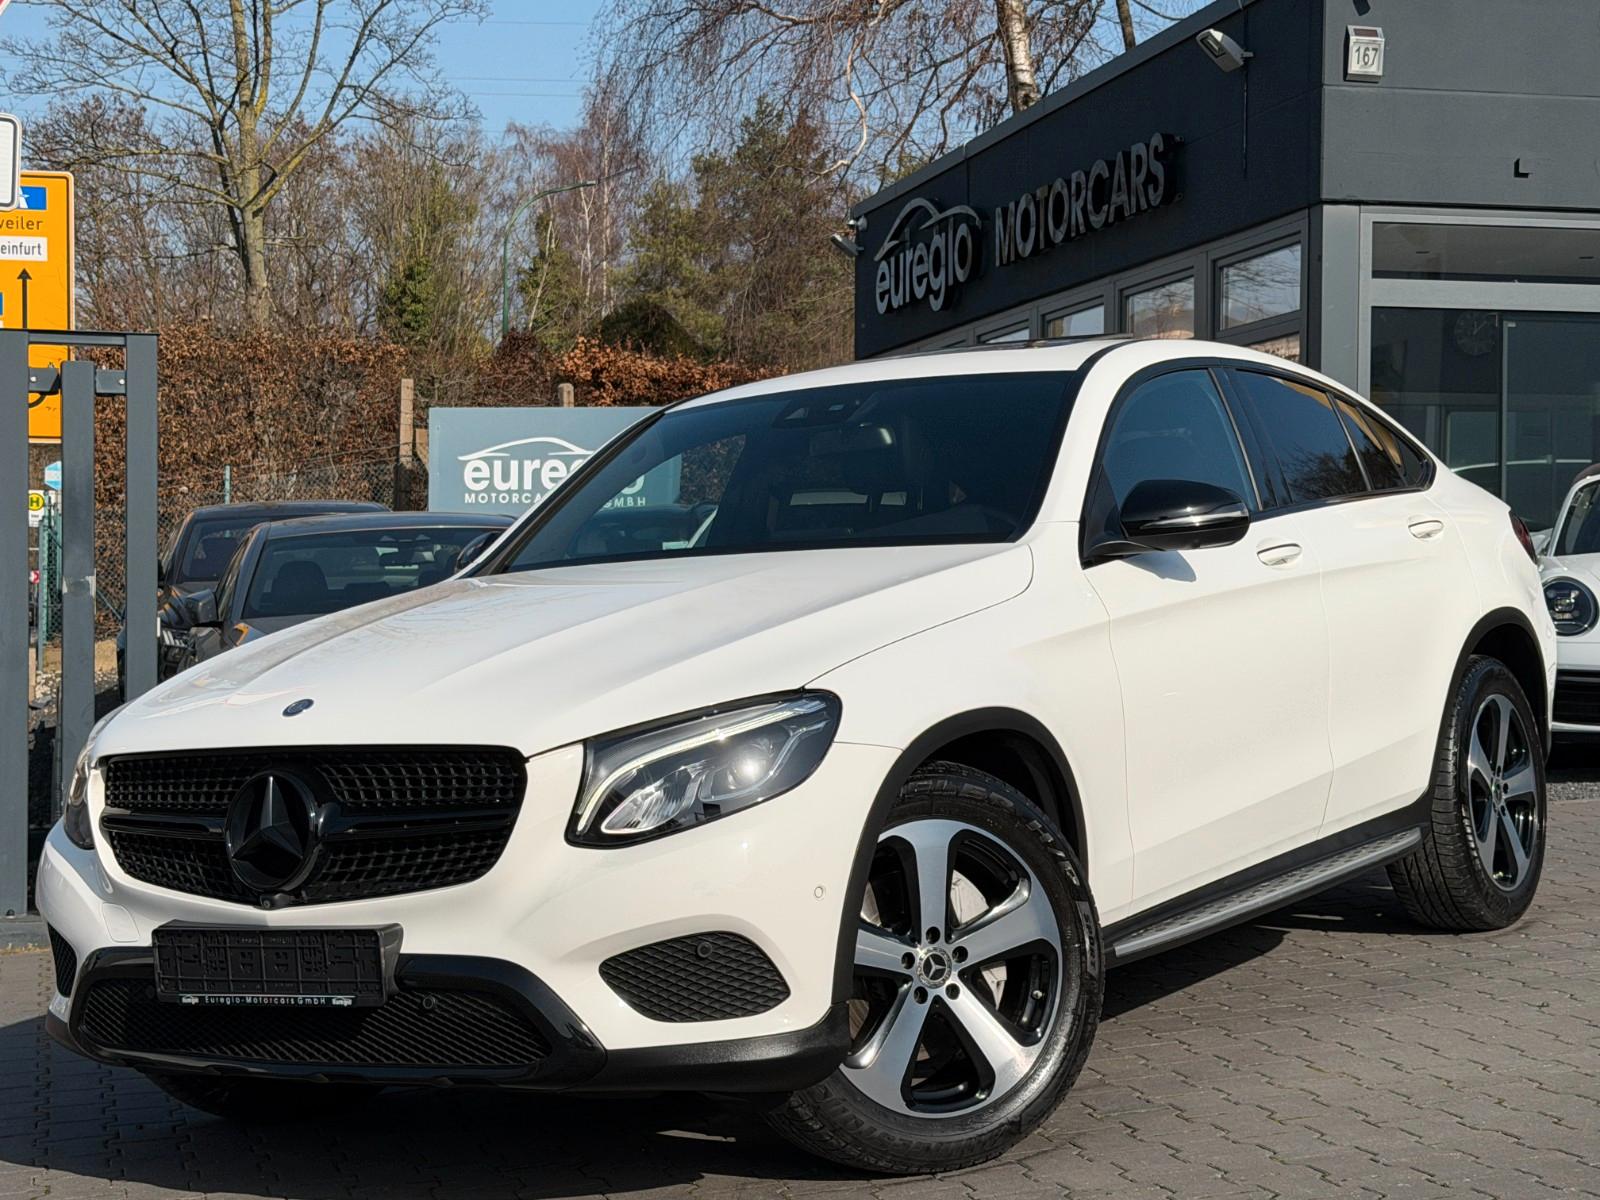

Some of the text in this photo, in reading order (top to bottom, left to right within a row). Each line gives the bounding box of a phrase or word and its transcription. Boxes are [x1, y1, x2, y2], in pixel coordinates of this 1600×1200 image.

[1355, 46, 1379, 66] 167
[995, 132, 1165, 267] MOTORCARS
[30, 497, 40, 507] H
